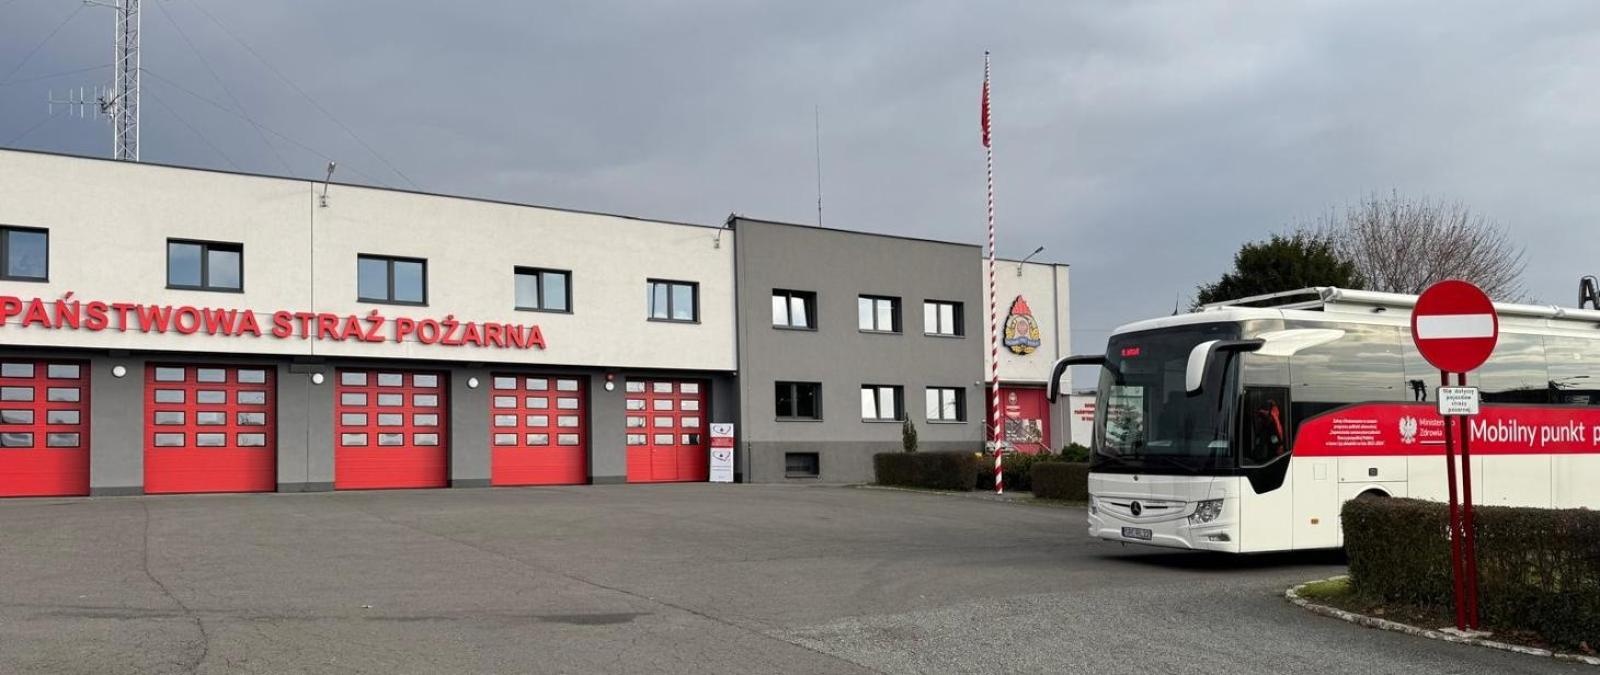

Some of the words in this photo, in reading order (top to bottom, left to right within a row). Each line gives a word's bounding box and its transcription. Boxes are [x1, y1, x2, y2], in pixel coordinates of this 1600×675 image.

[0, 291, 261, 337] PAŃSTWOWA
[272, 309, 385, 342] STRAŻ
[395, 315, 546, 349] POŻARNA
[1419, 428, 1443, 437] Zdrowia
[1470, 419, 1537, 447] Mobilny
[1541, 419, 1586, 447] punkt
